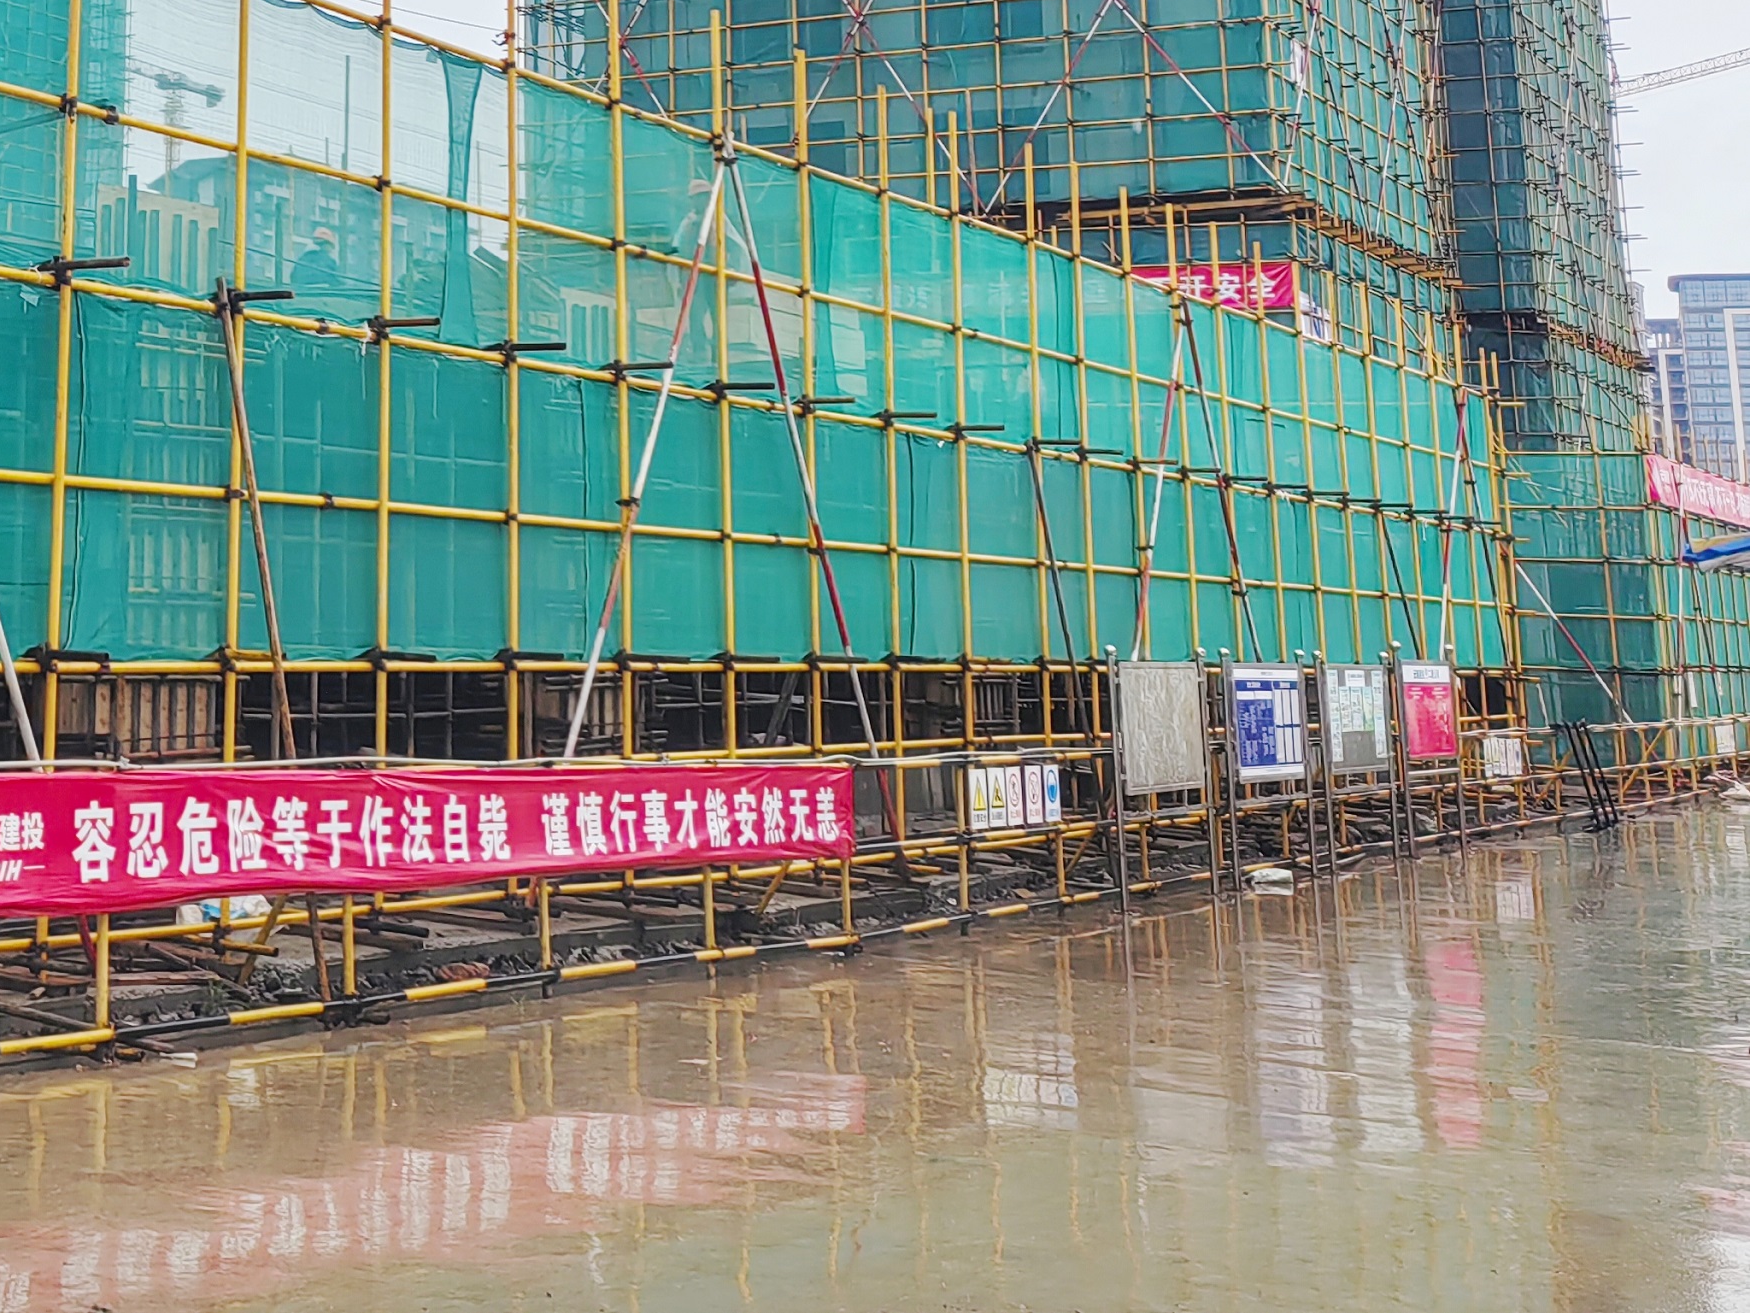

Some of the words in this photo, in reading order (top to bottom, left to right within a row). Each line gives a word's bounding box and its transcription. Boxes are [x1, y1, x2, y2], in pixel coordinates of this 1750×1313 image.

[71, 793, 511, 884] 容忍危险等于作法自毙
[541, 786, 840, 857] 谨慎行事才能安然无恙
